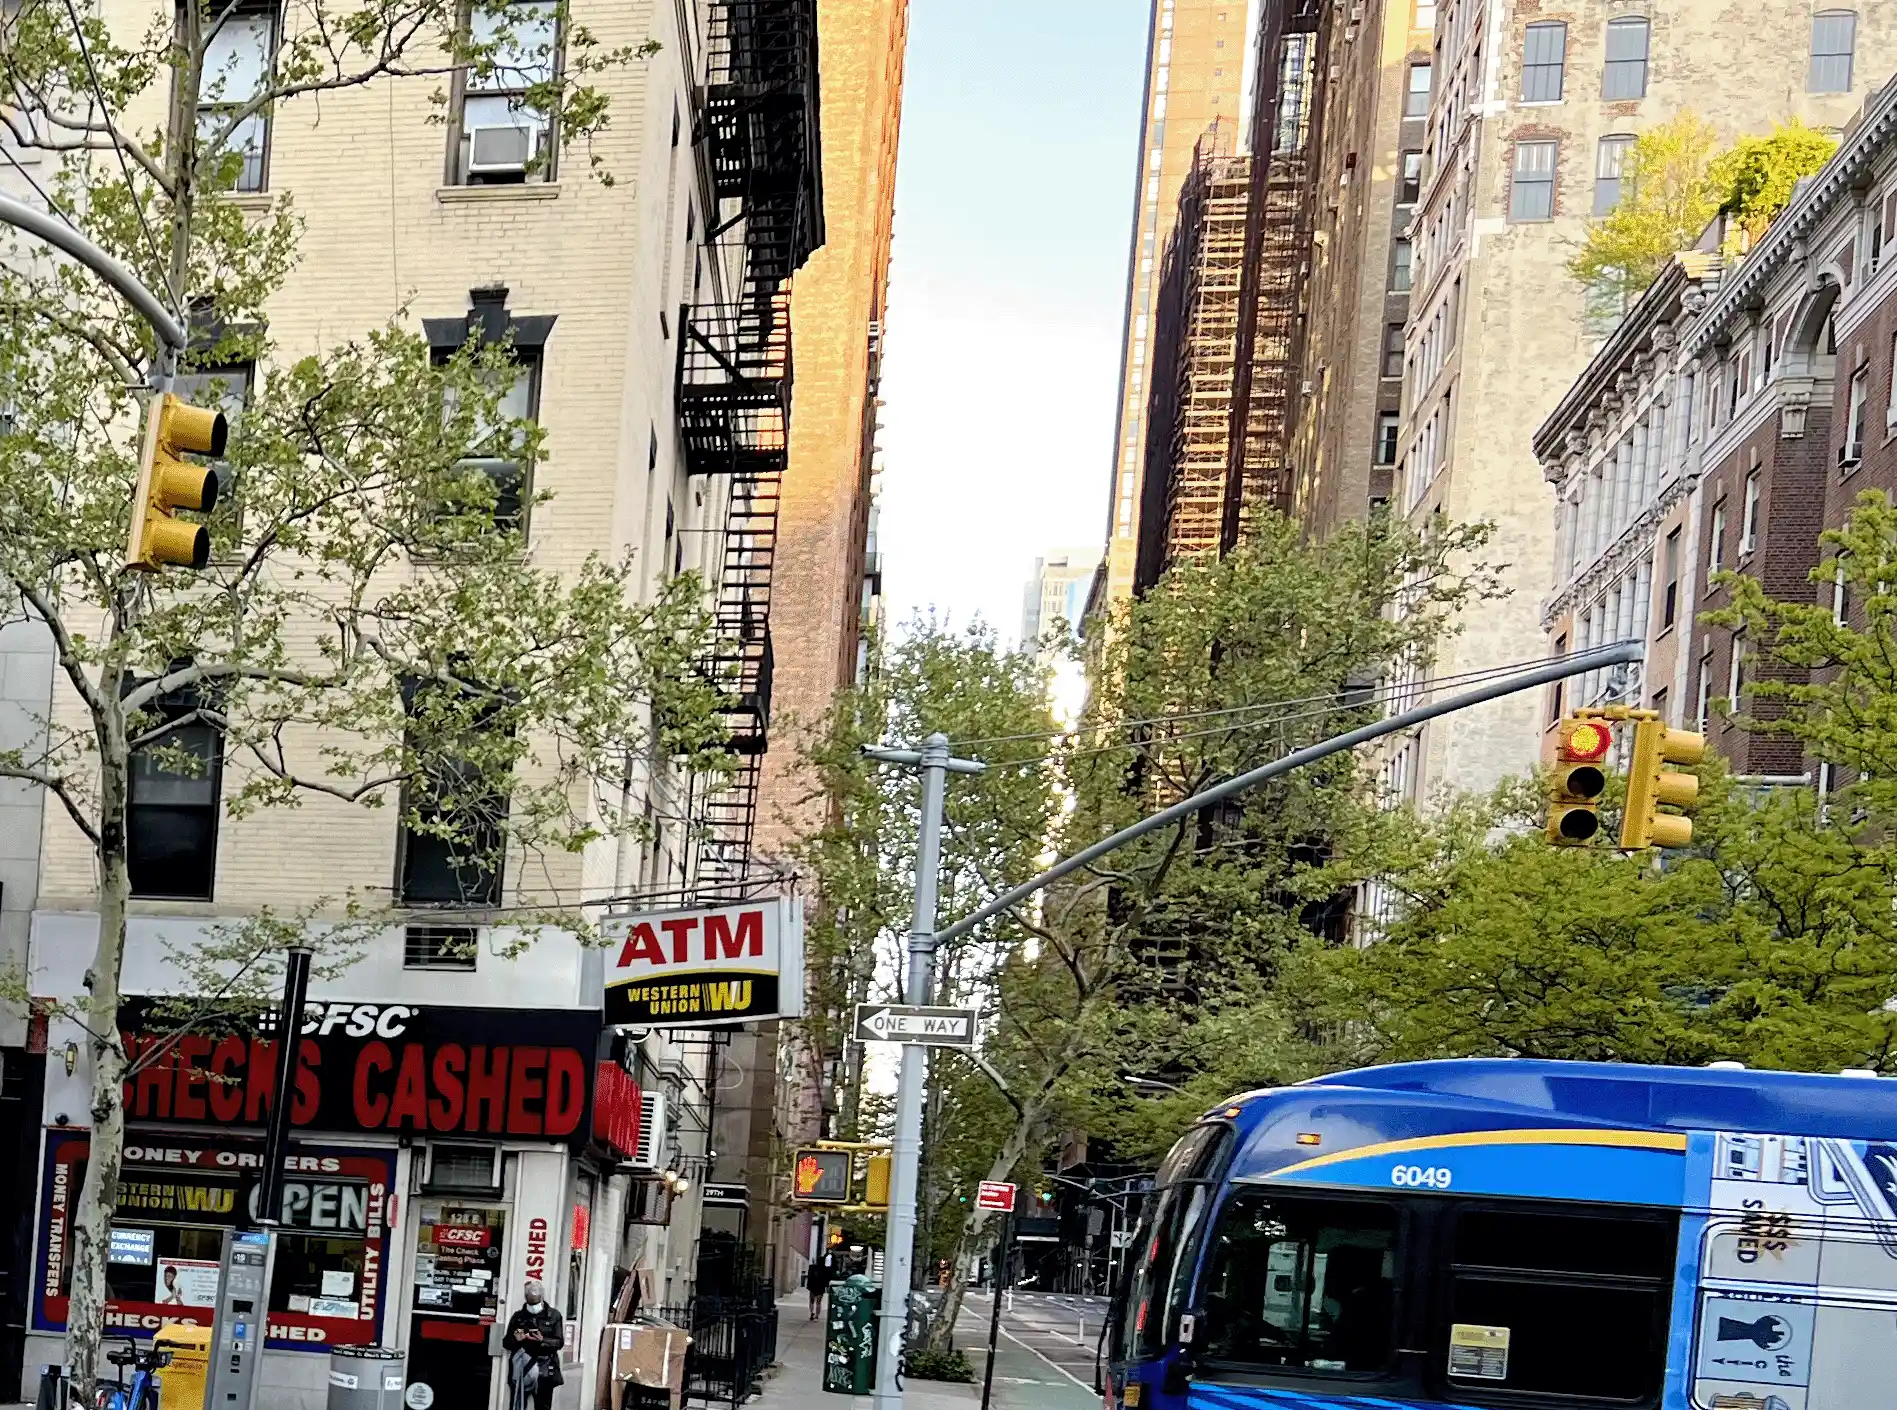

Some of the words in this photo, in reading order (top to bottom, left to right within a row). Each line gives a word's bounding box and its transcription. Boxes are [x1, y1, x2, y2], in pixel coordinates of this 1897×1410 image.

[616, 911, 763, 968] ATM
[628, 983, 700, 1003] WESTERN
[707, 980, 753, 1012] WU
[649, 998, 700, 1016] UNION
[874, 1016, 907, 1031] ONE
[923, 1019, 959, 1034] WAY
[123, 1032, 322, 1126] HECKS
[352, 1040, 585, 1136] CASHED
[123, 1146, 203, 1165] ONEY
[215, 1151, 340, 1172] ORERS
[53, 1163, 69, 1213] MONEY
[1391, 1164, 1452, 1189] 6049
[116, 1181, 175, 1199] STERN
[116, 1194, 175, 1210] UNION
[367, 1182, 385, 1239] BILLS
[110, 1242, 150, 1252] EXCHANGE
[111, 1231, 152, 1242] CURRENCY
[447, 1228, 485, 1241] CFSC
[45, 1216, 65, 1297] TRANSFERS
[525, 1217, 548, 1282] ASHED
[360, 1246, 380, 1321] UTILITY
[105, 1312, 199, 1329] HECKS
